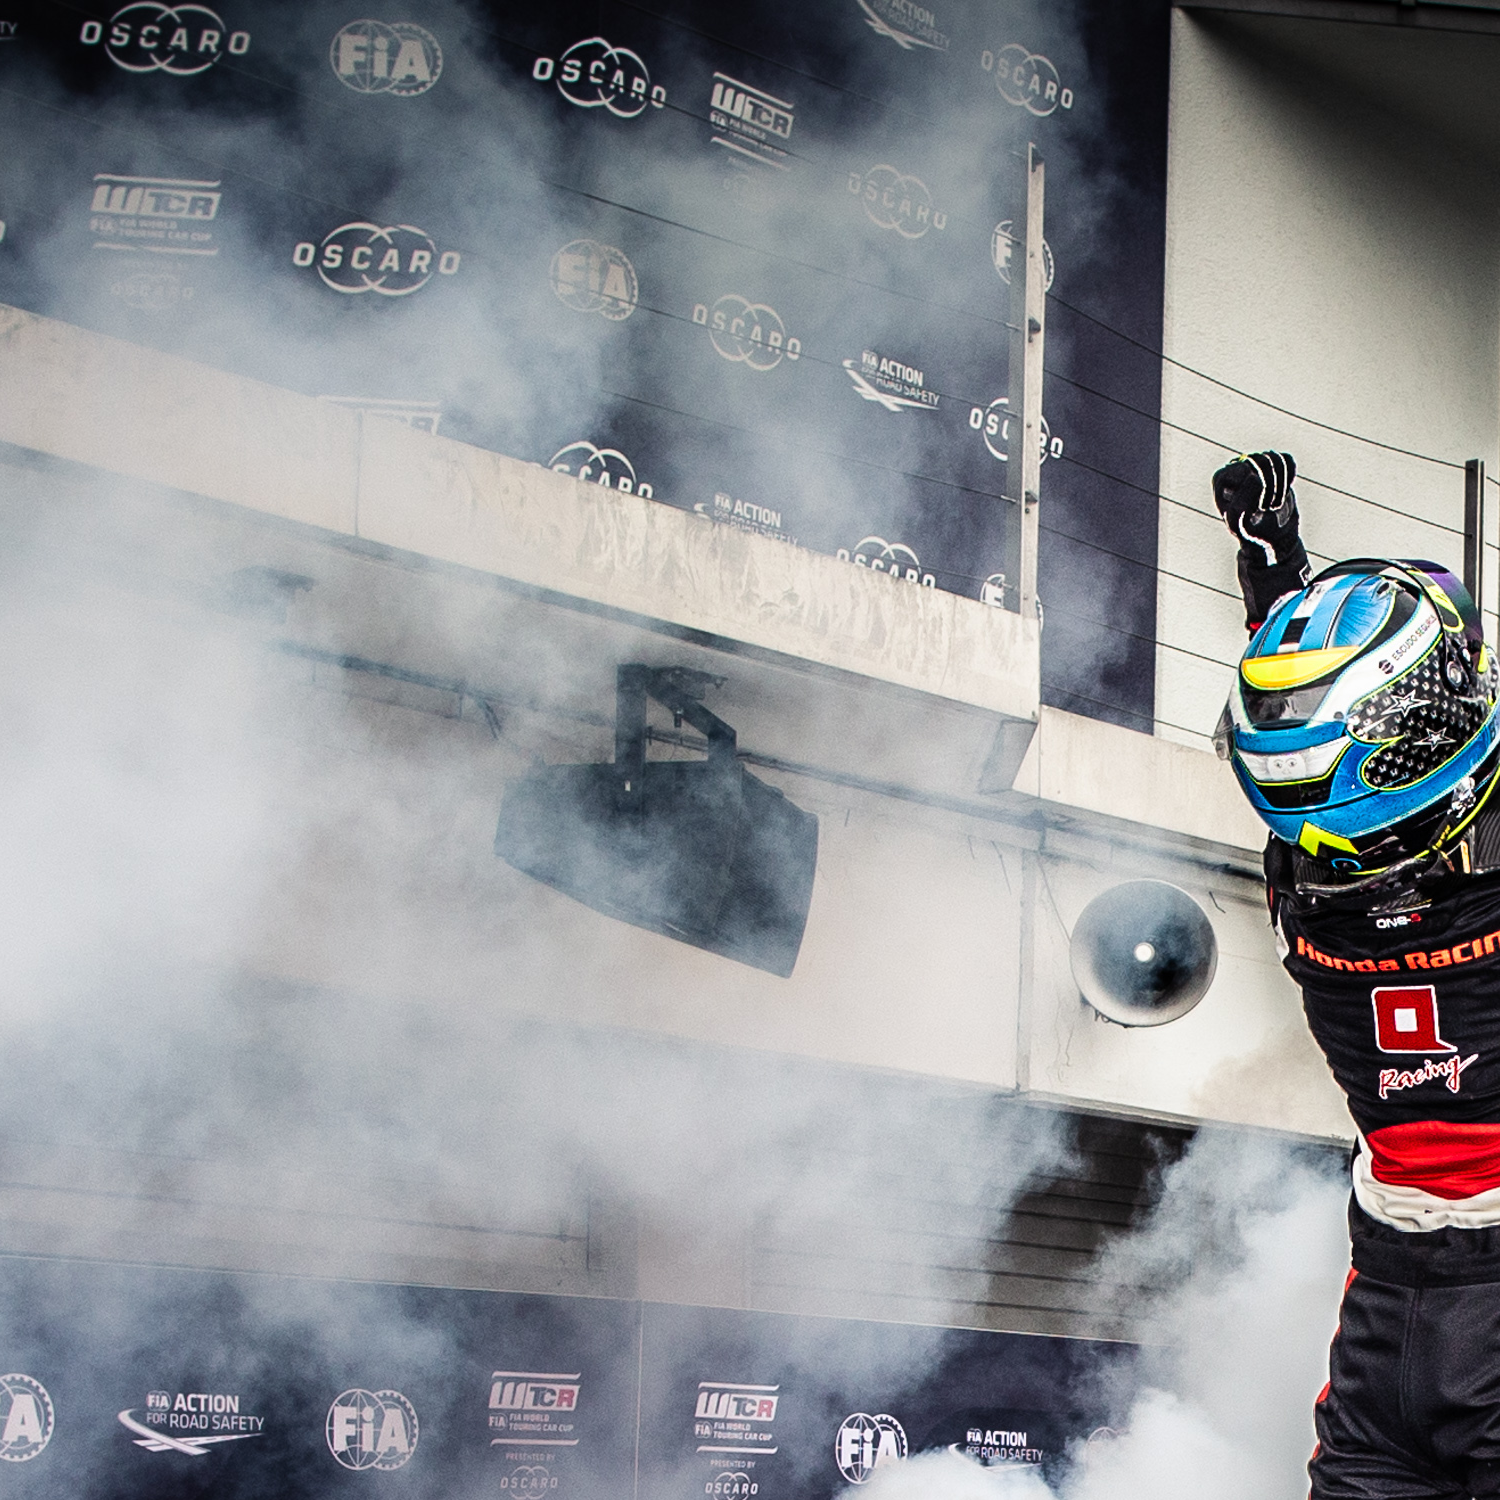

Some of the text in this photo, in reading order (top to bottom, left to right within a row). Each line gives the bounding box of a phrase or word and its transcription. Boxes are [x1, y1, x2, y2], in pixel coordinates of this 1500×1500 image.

[80, 20, 251, 55] OSCARO
[533, 57, 667, 108] OSCARO
[981, 50, 1074, 110] OSCARO
[711, 83, 794, 138] WTCR
[90, 185, 221, 220] WTCR
[293, 242, 461, 275] OSCARO
[692, 303, 801, 361] OSCARO
[879, 356, 924, 387] ACTION
[733, 499, 781, 528] ACTION
[1296, 936, 1400, 974] Honda
[1379, 1052, 1480, 1100] Racing
[173, 1392, 239, 1414] ACTION
[489, 1382, 581, 1411] WTCR
[695, 1392, 779, 1421] WTCR
[146, 1412, 265, 1433] FOR ROAD SAFETY
[523, 1414, 550, 1422] WORLD
[713, 1422, 752, 1432] FIA WORLD
[713, 1431, 773, 1441] TOURING CAR CUP
[984, 1429, 1027, 1447] ACTION
[709, 1459, 756, 1469] PRESENTED BY
[980, 1446, 1044, 1462] ROAD SAFETY
[500, 1475, 559, 1490] OSCARO
[705, 1480, 759, 1495] OSCARO
